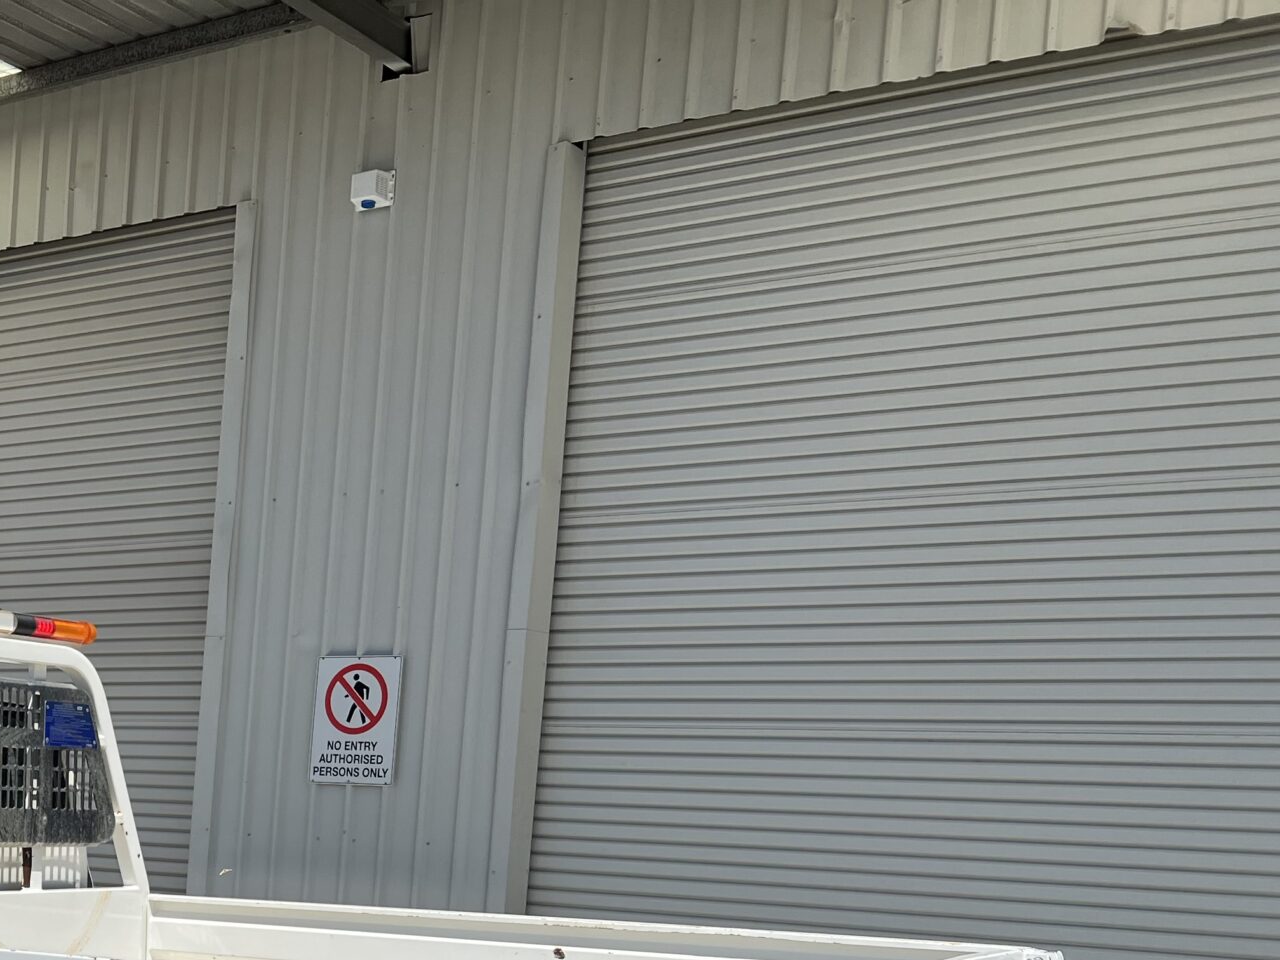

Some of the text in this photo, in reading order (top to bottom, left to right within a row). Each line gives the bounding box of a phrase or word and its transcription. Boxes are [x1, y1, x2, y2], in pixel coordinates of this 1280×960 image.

[327, 740, 378, 752] NO ENTRY
[319, 753, 384, 765] AUTHORISED
[312, 766, 389, 778] PERSONS ONLY
